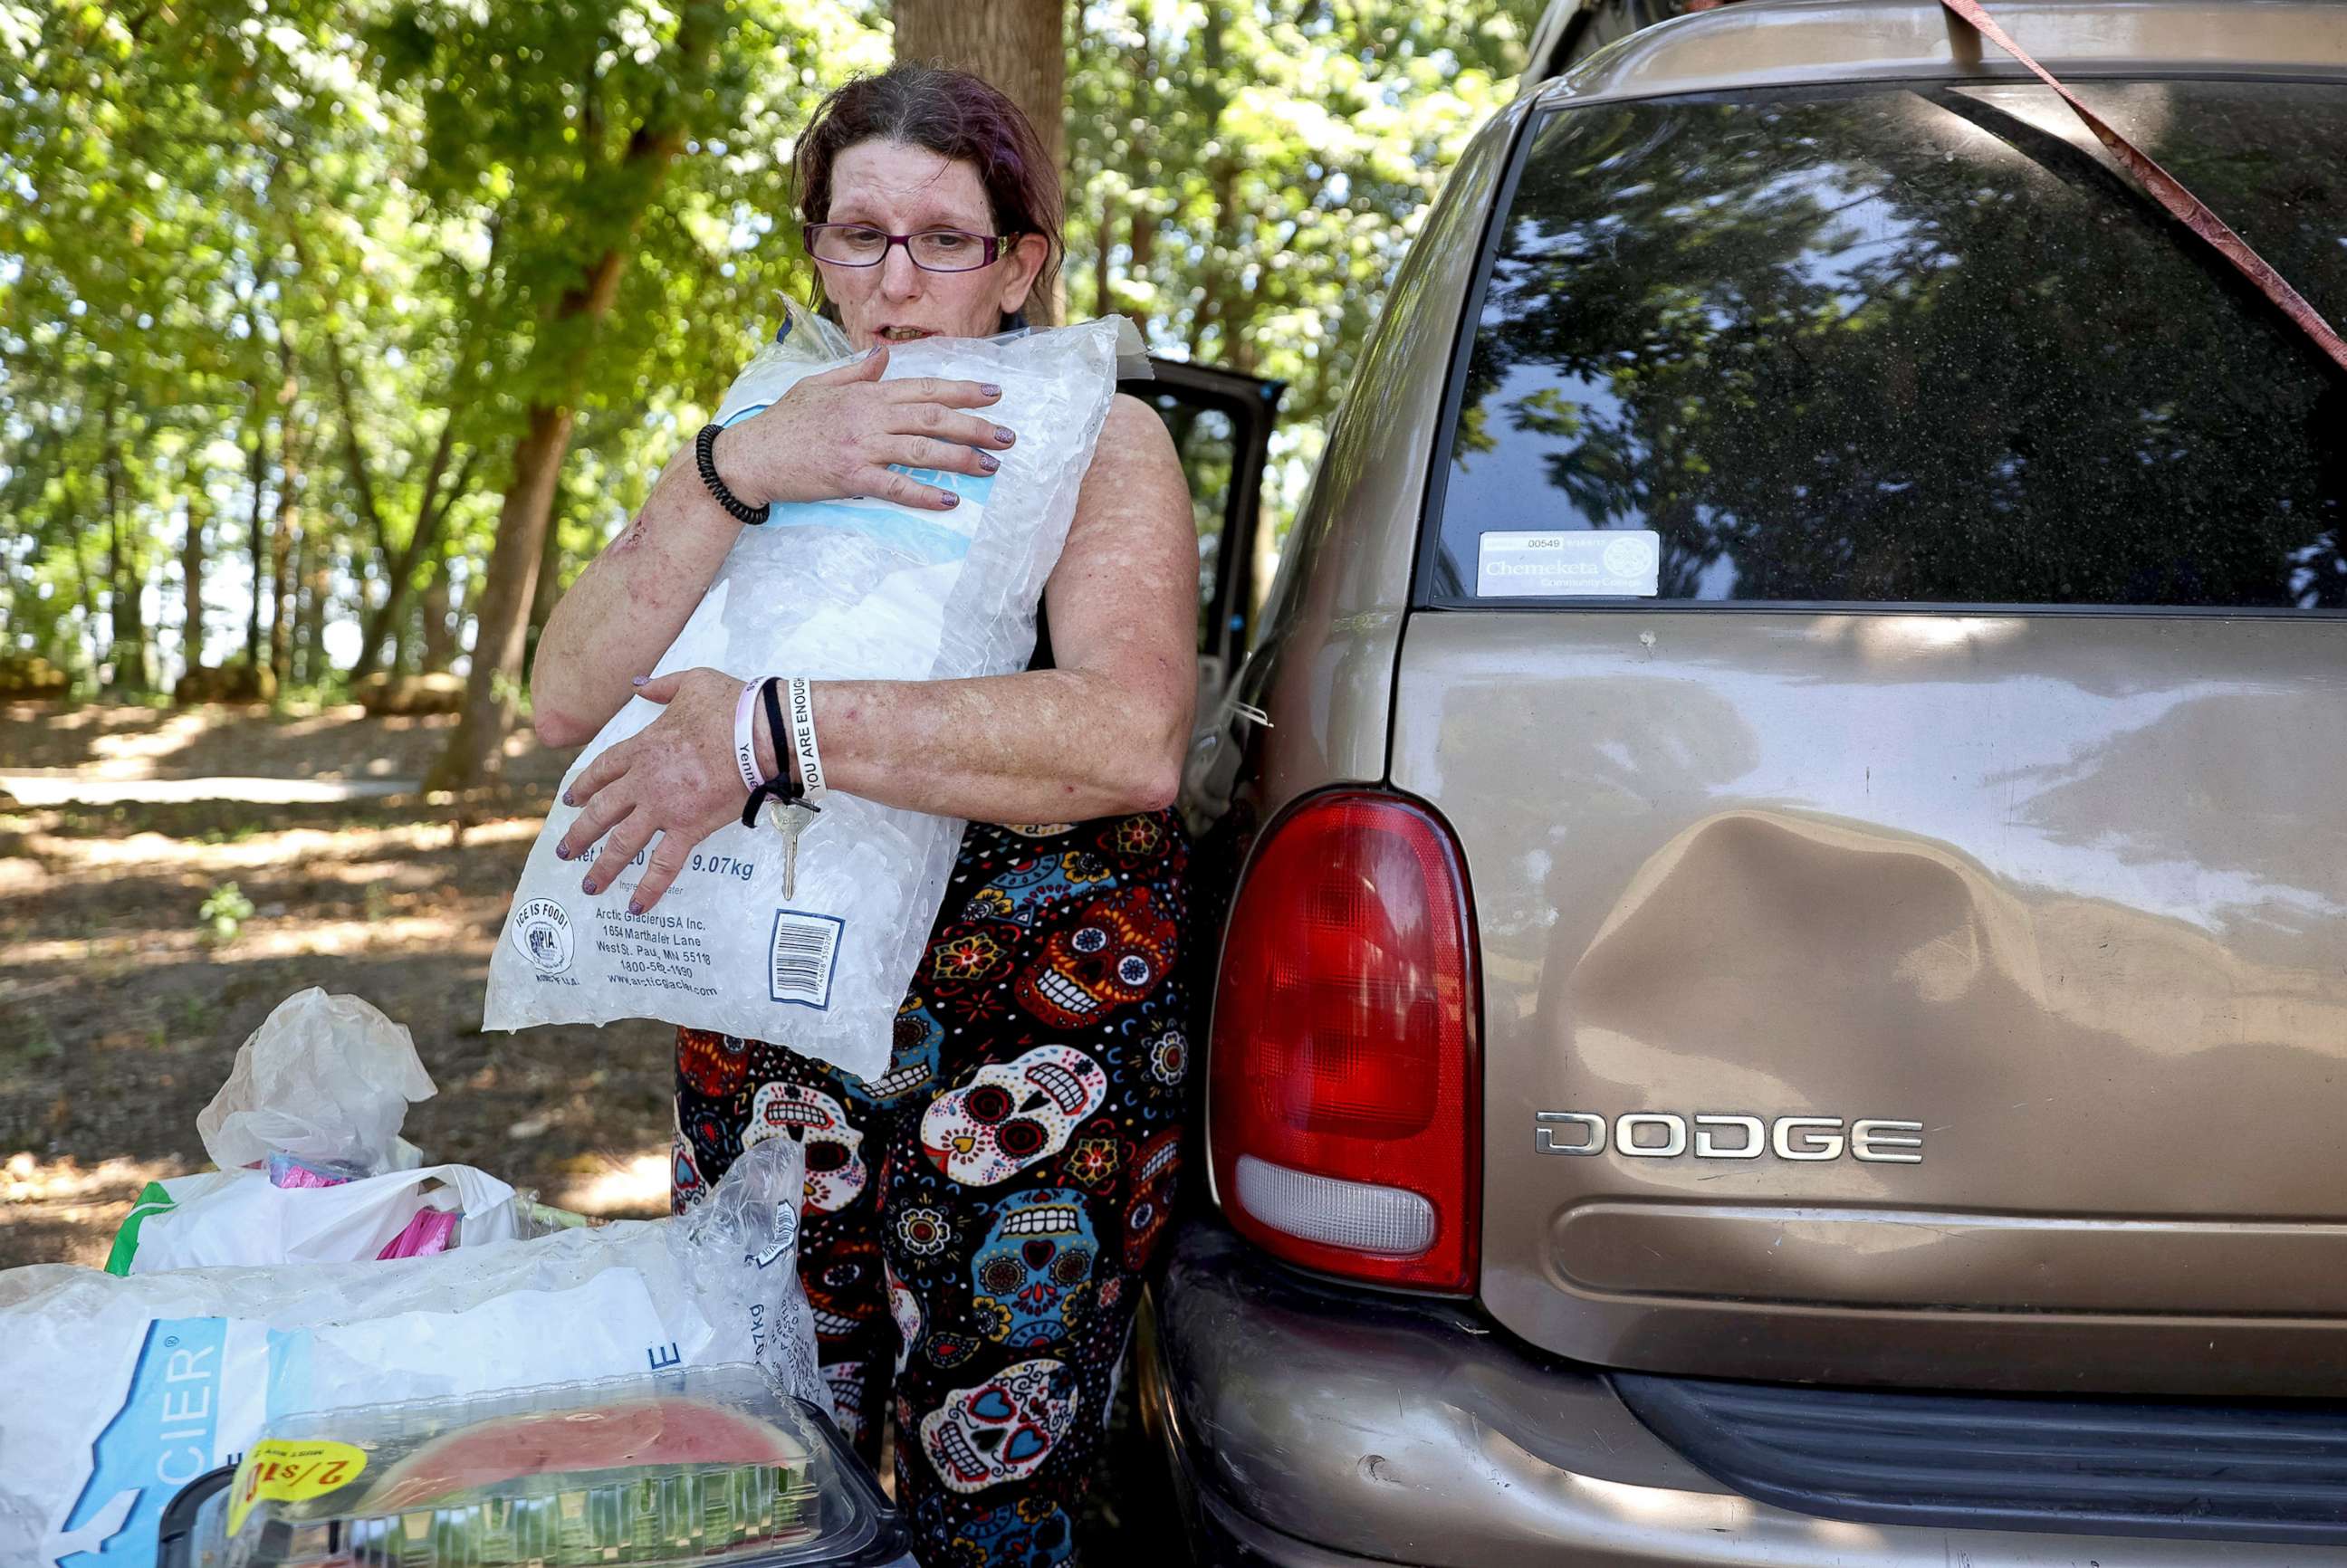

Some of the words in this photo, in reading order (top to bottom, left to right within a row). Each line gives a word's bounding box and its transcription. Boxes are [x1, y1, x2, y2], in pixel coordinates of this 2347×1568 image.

[1528, 539, 1560, 549] 00549
[1486, 560, 1598, 576] Chemeketa
[798, 726, 814, 758] ARE
[739, 742, 759, 790] Yenne
[804, 762, 820, 792] YOU
[692, 855, 754, 881] 9.07kg
[516, 908, 529, 928] ICE
[530, 904, 540, 916] IS
[542, 904, 568, 930] FOOD!
[596, 907, 622, 921] Arctic
[686, 917, 706, 931] Inc.
[673, 934, 702, 947] Lane
[663, 949, 680, 961] MN
[1534, 1111, 1924, 1164] DODGE
[157, 1344, 216, 1486] CIER
